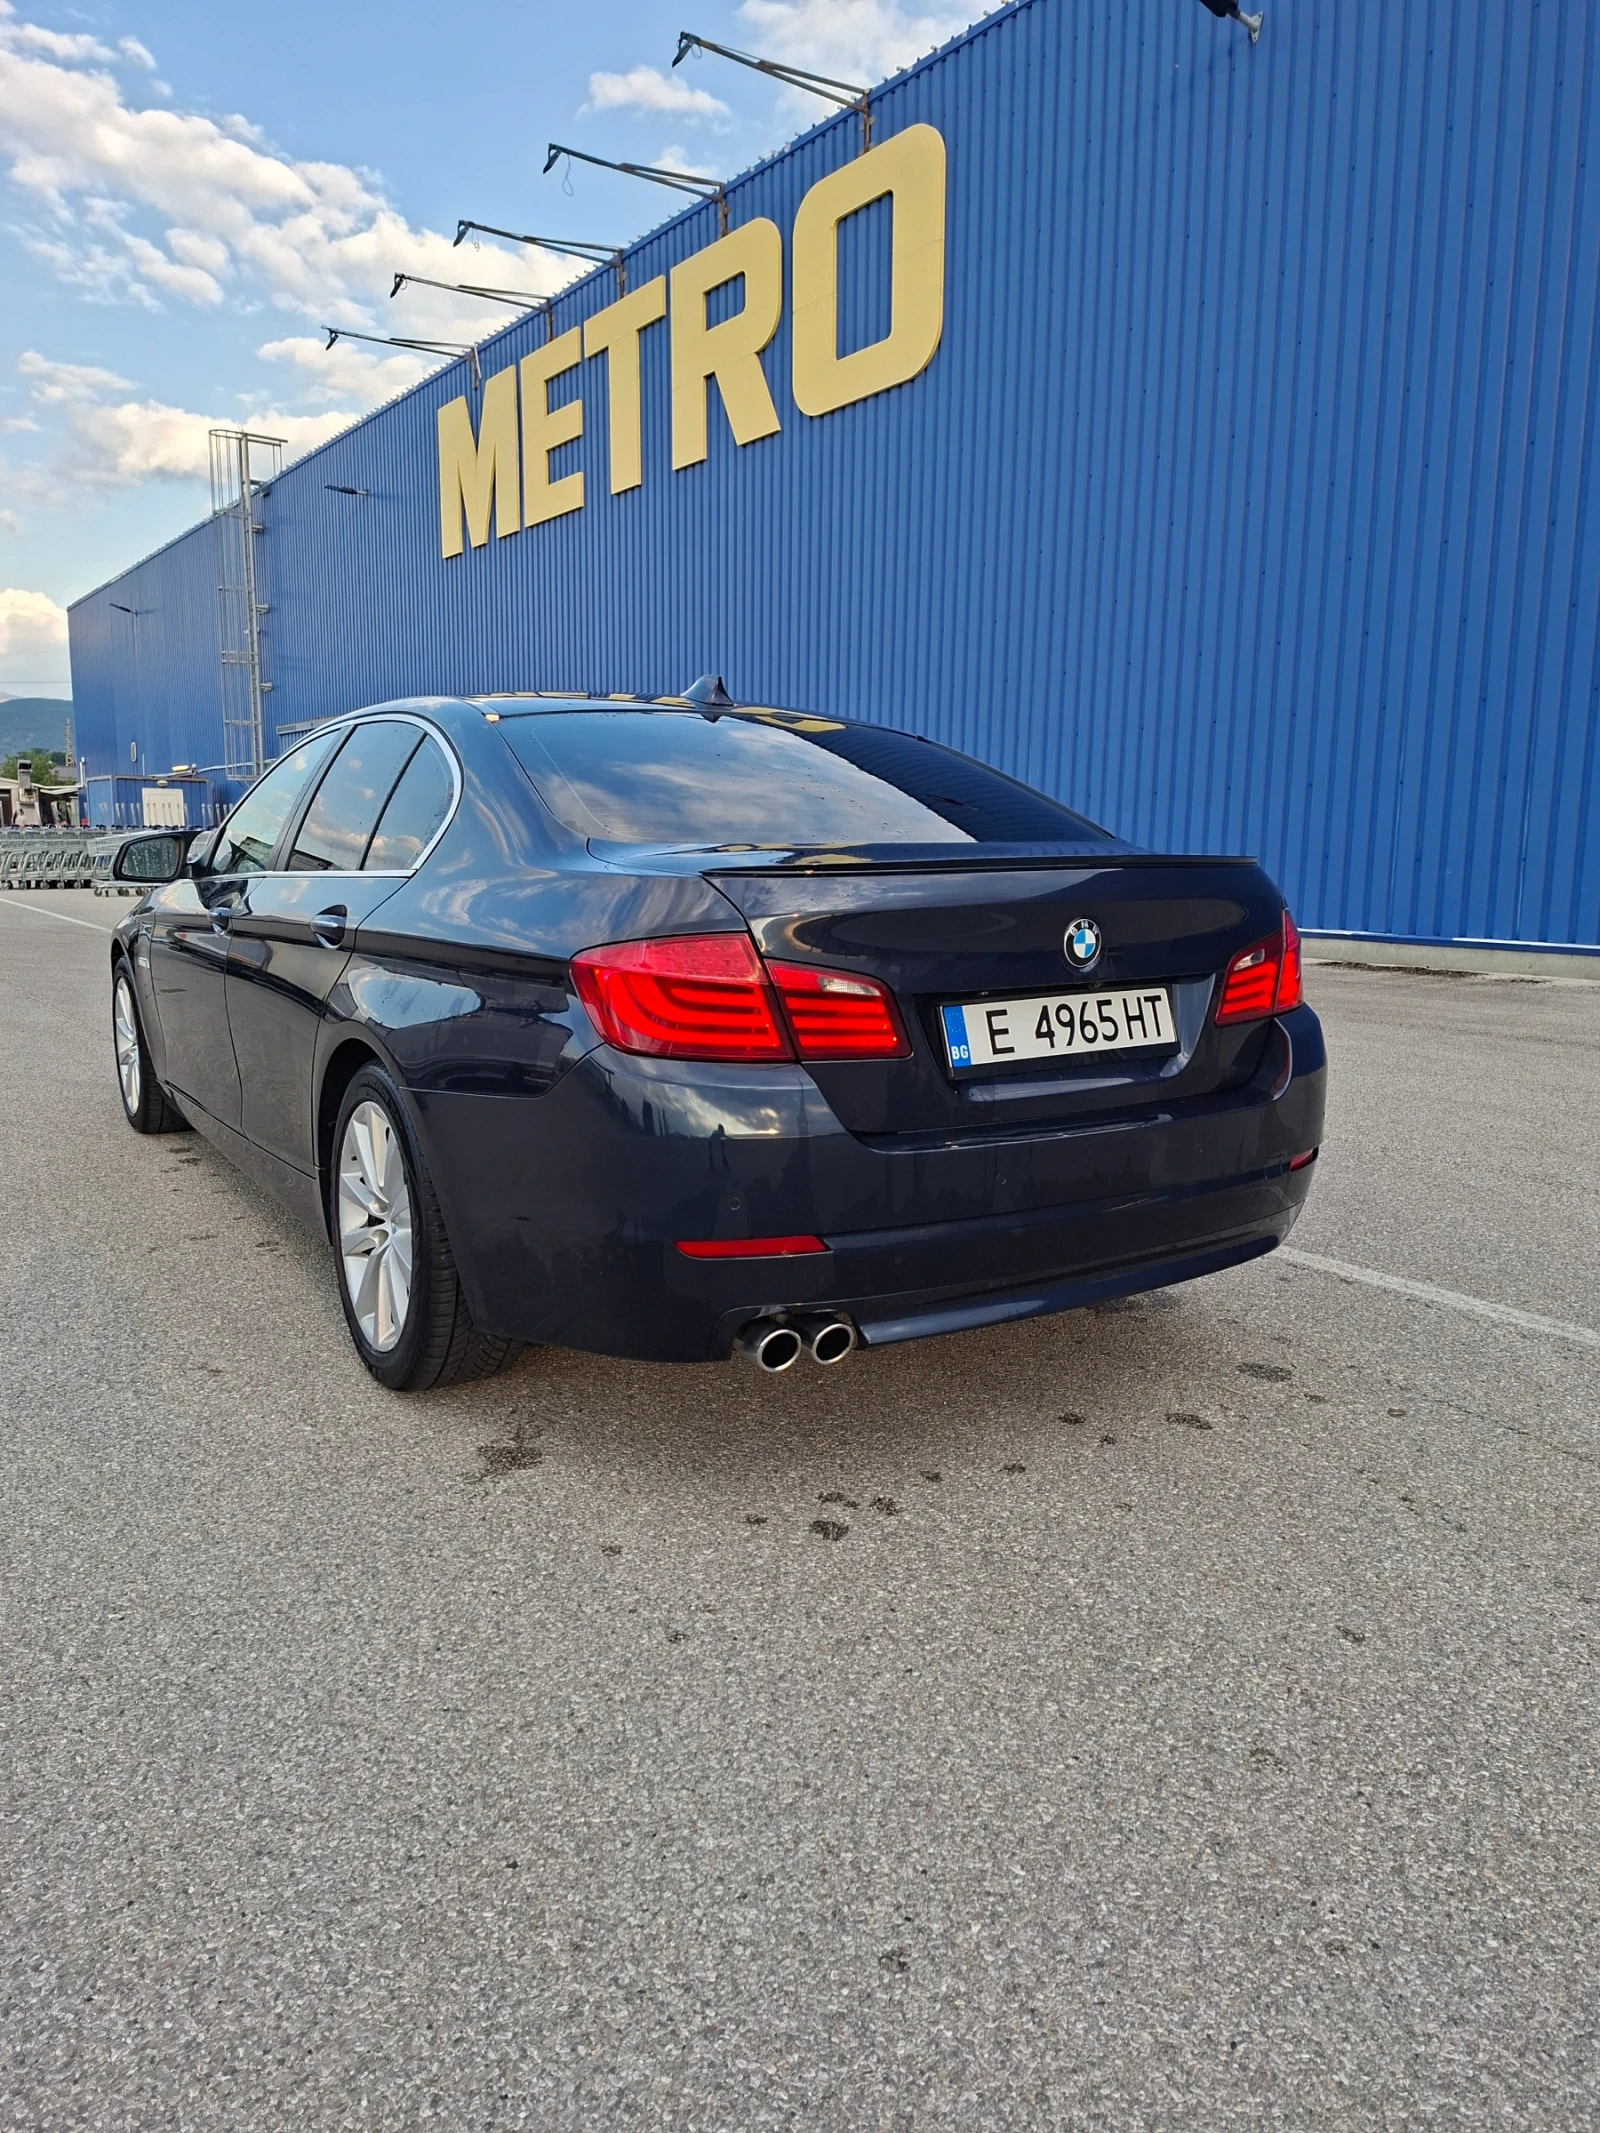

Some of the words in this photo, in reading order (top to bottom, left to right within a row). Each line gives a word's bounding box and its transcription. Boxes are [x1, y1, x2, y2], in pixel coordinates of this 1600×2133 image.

[437, 122, 947, 560] METRO
[1069, 920, 1100, 937] BMW
[985, 1008, 1016, 1056] E
[951, 1044, 969, 1060] BG
